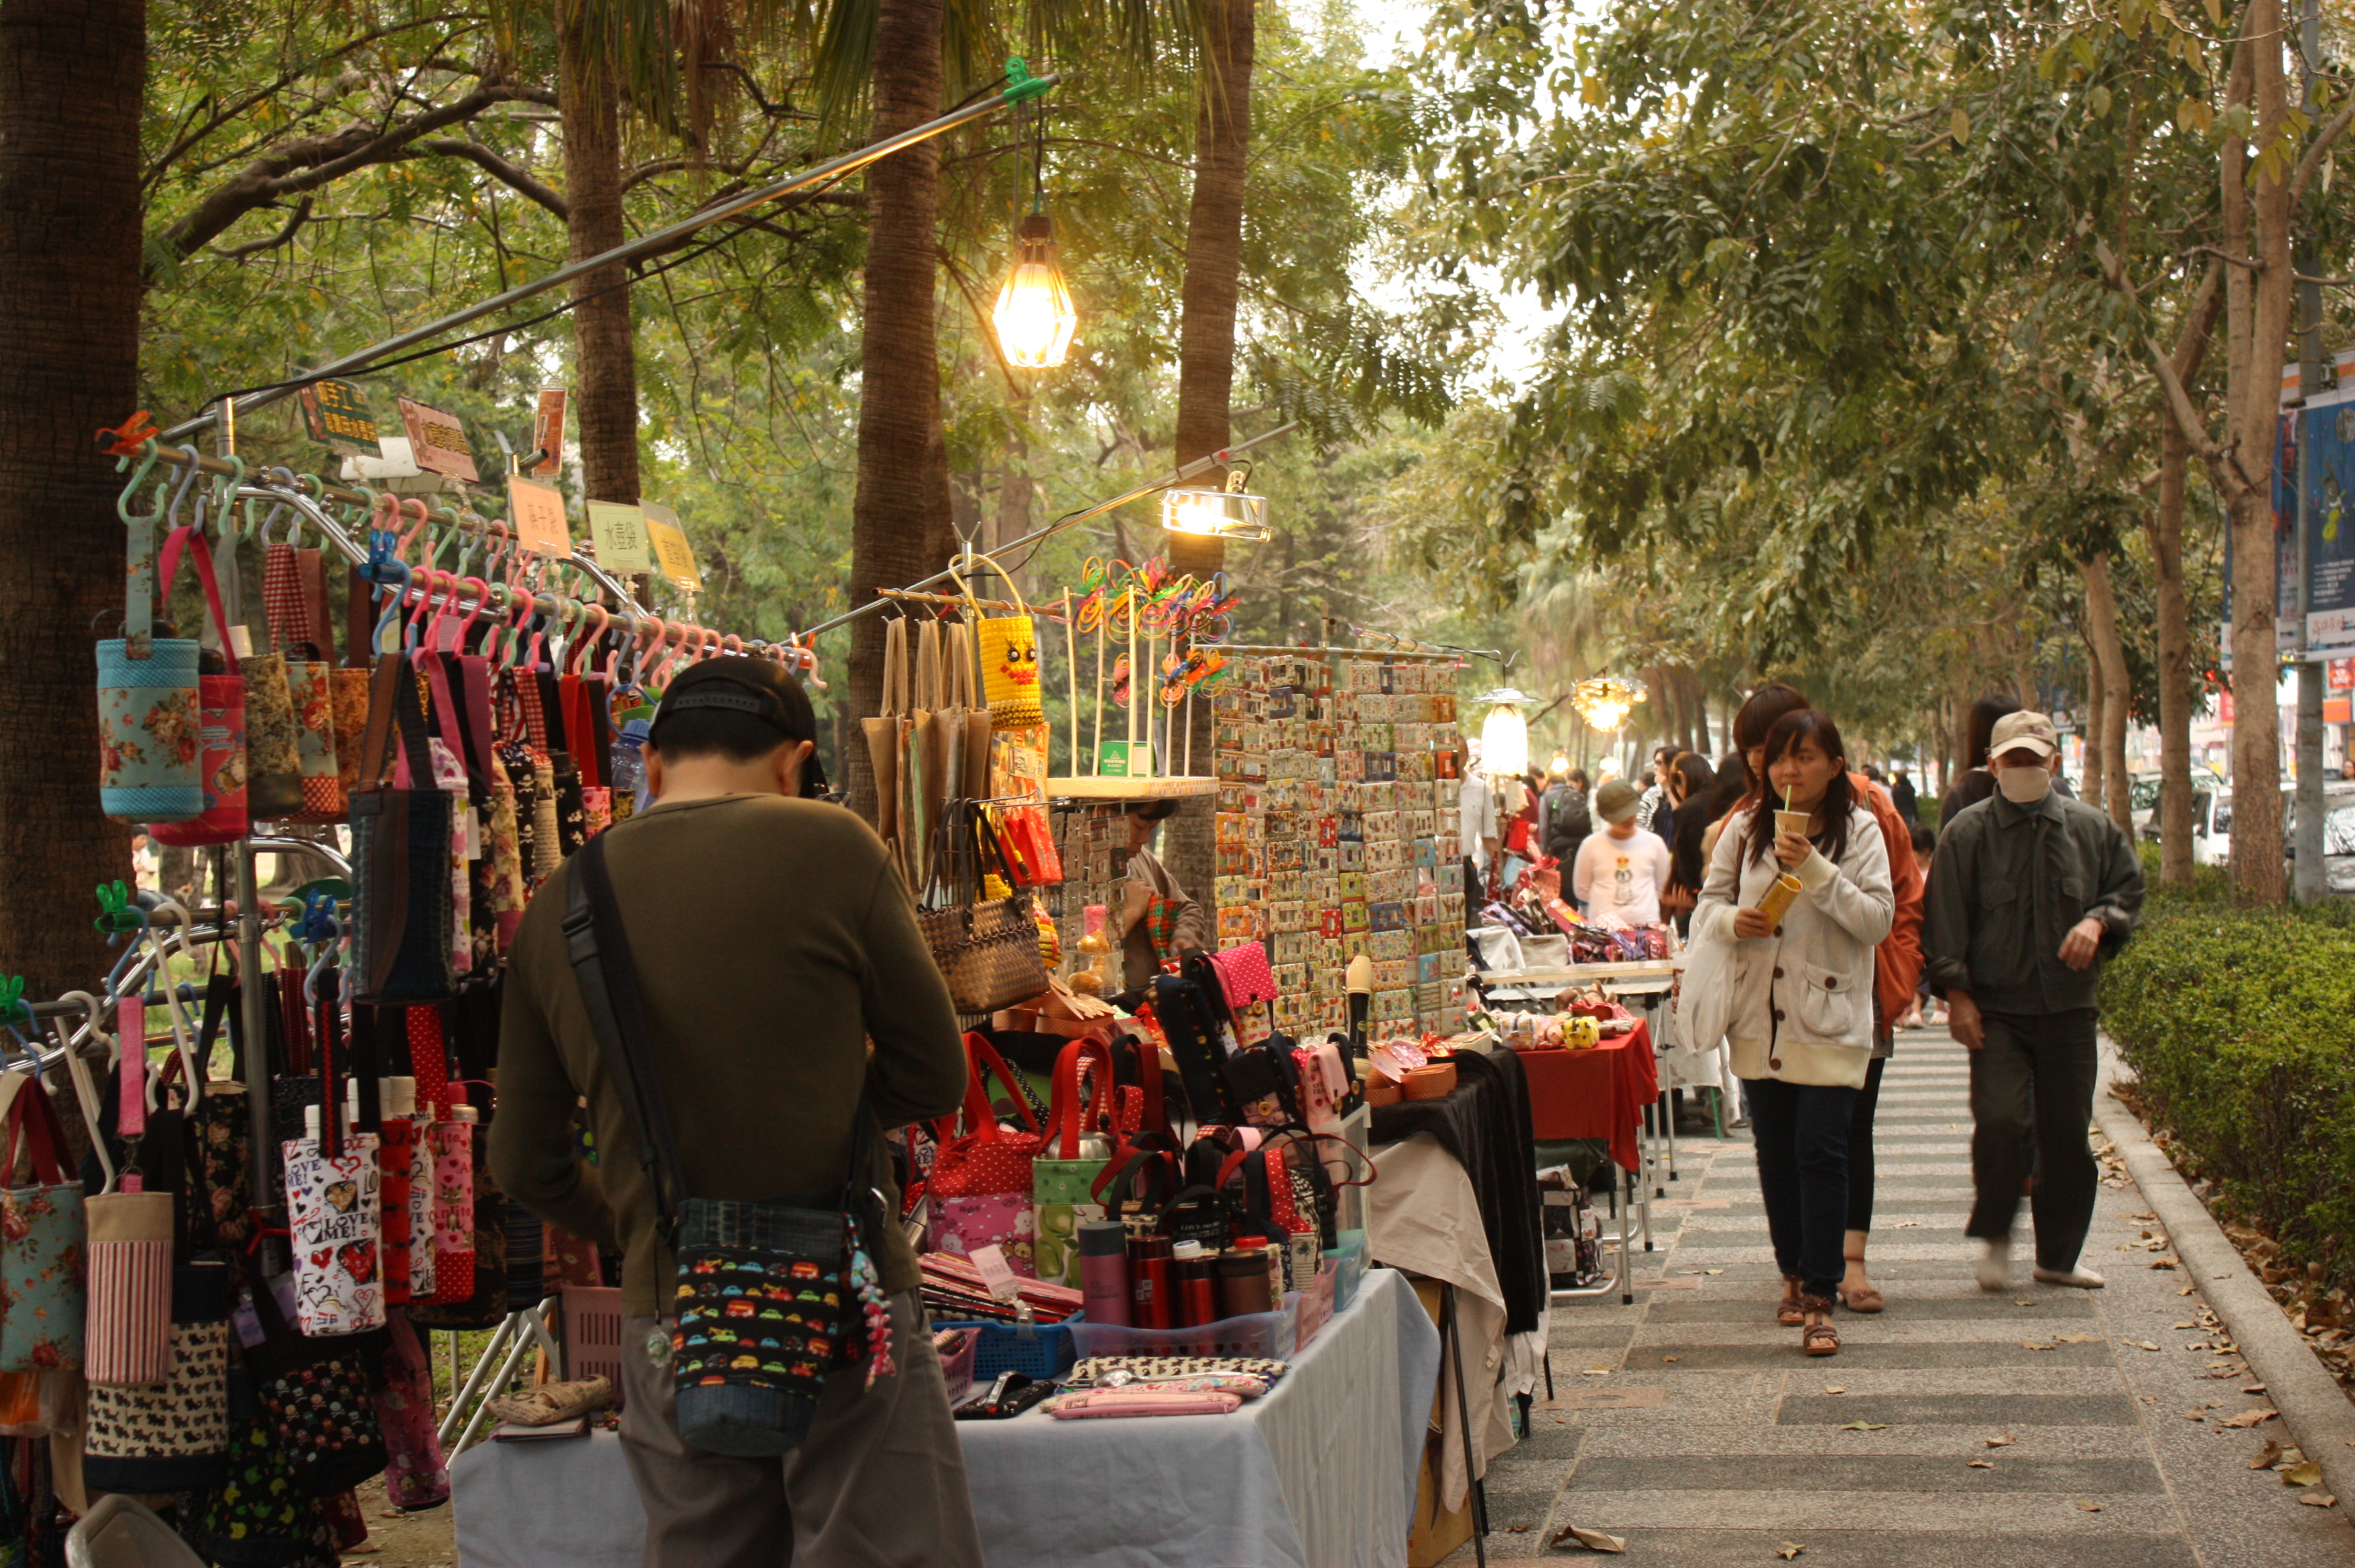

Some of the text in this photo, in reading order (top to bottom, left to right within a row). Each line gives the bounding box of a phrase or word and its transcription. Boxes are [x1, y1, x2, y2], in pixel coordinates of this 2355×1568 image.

[604, 521, 638, 550] 水壺袋
[324, 1212, 370, 1230] LOVE
[323, 1226, 356, 1242] ME!
